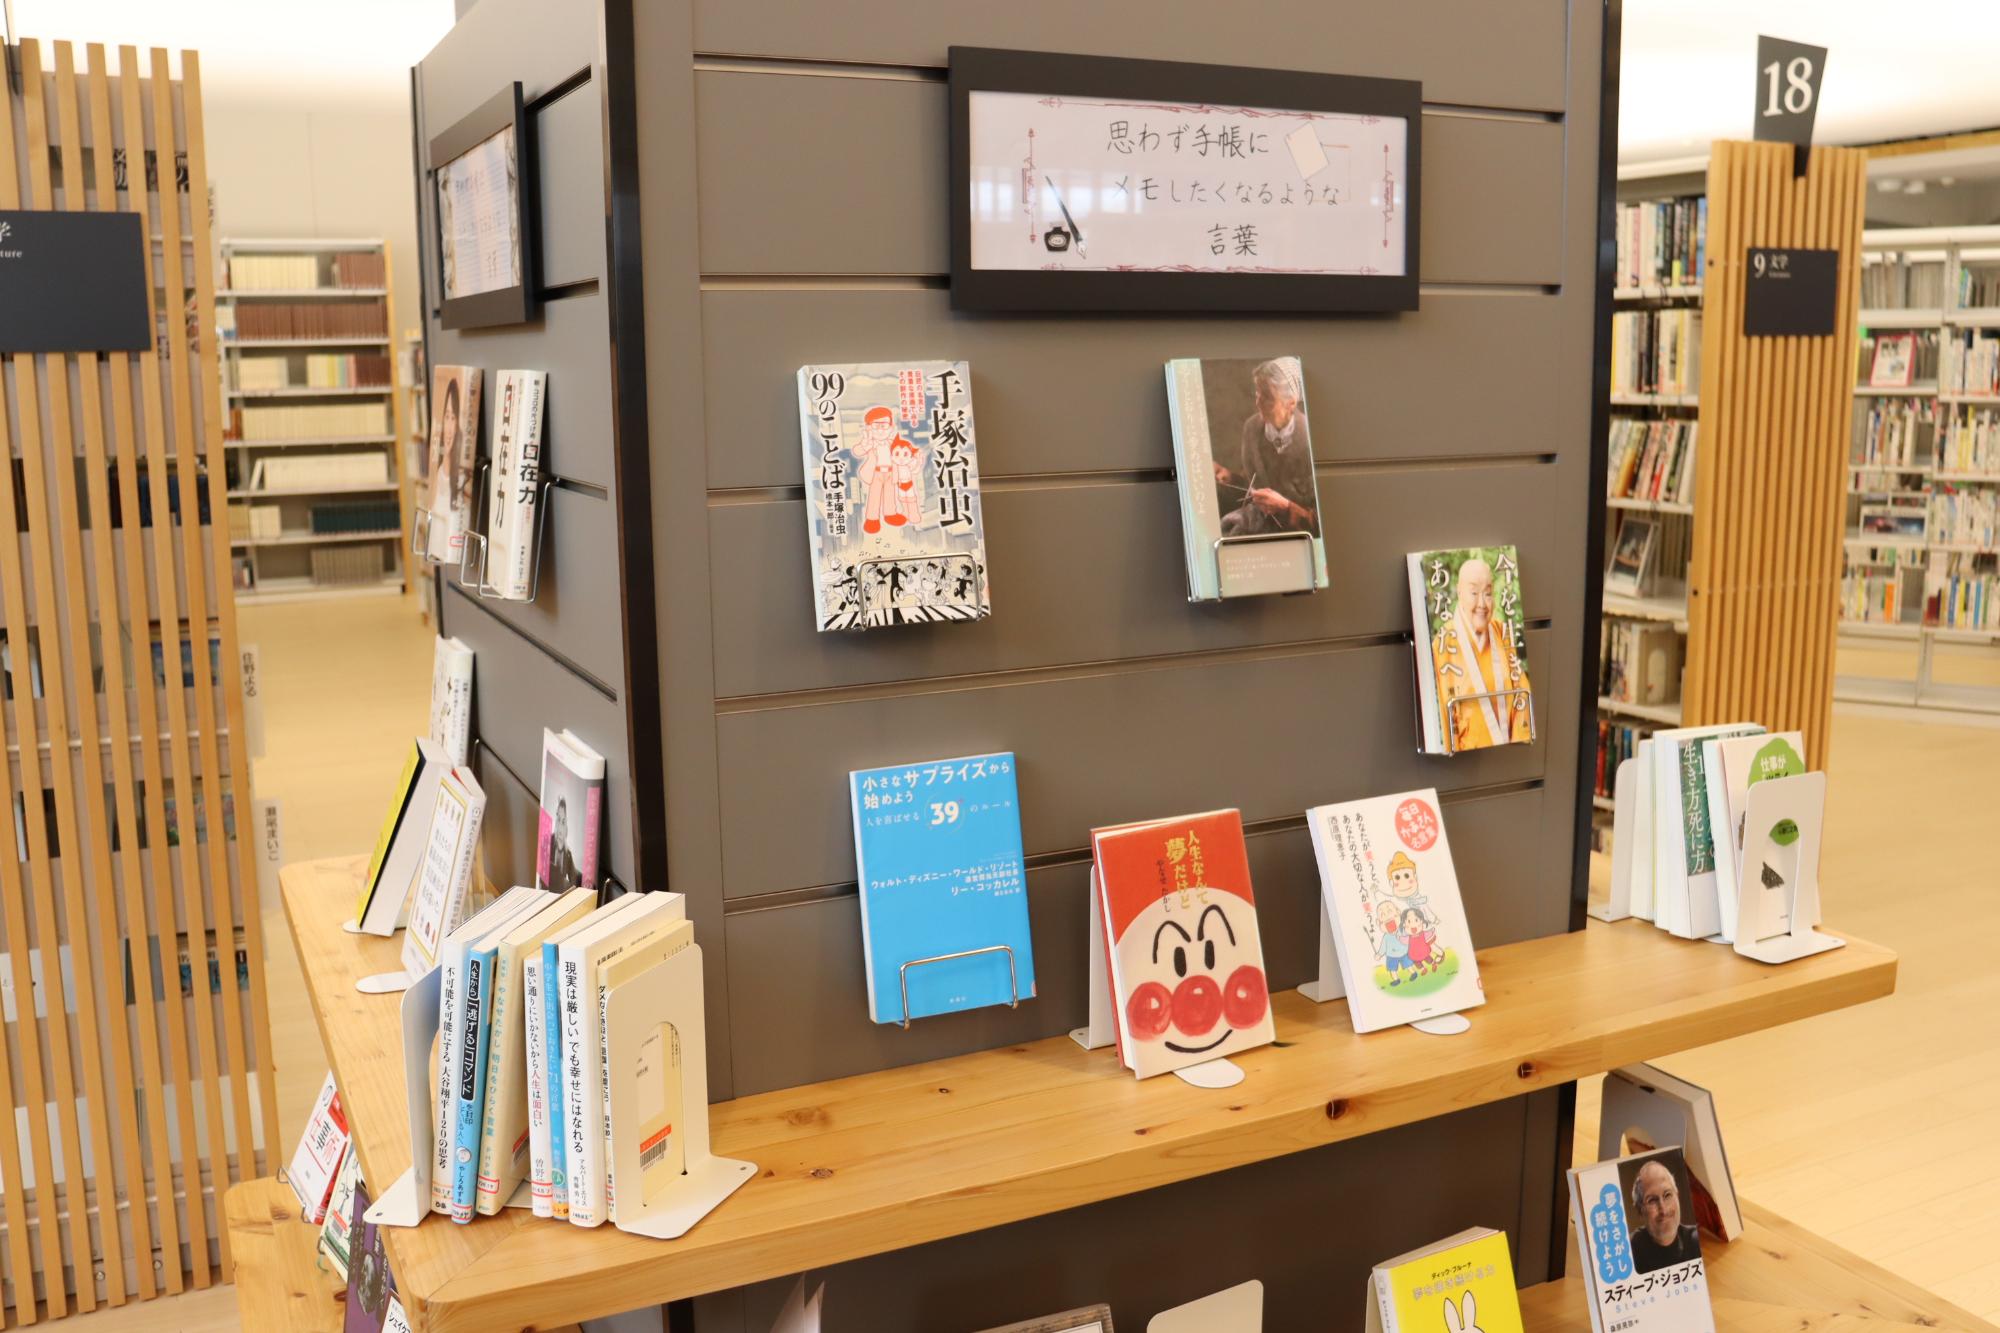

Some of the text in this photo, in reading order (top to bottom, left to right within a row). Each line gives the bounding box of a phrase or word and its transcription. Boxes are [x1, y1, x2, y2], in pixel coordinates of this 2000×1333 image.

[1763, 56, 1813, 117] 18
[1107, 120, 1270, 159] 思わず手帳に
[1114, 175, 1340, 207] メモしたくなるような
[1208, 223, 1259, 257] 言葉
[1754, 253, 1766, 278] 9
[811, 372, 845, 490] 99のことば
[928, 370, 973, 527] 手塚治虫
[833, 492, 846, 535] 手塚治虫
[1430, 559, 1464, 678] あなたへ
[1494, 553, 1528, 711] 今を生きる
[862, 759, 1011, 793] 小さなサプライズから
[864, 791, 914, 811] 始めよう
[1683, 743, 1706, 874] 生き方死に方
[930, 801, 960, 826] 39
[1164, 836, 1191, 909] 夢だけど
[1187, 829, 1209, 904] 人生なんて
[441, 967, 456, 1063] 不可能を可能にする
[527, 966, 543, 1128] 思い通りにいかないから人生は面白い
[564, 961, 583, 1154] 現実は厳しいでも幸せにはなれる
[1595, 1211, 1614, 1278] 続けよう
[1605, 1191, 1628, 1273] 夢をさがし
[1604, 1260, 1704, 1304] スティーブ・ジョブズ
[1615, 1283, 1699, 1314] Steve Jobs
